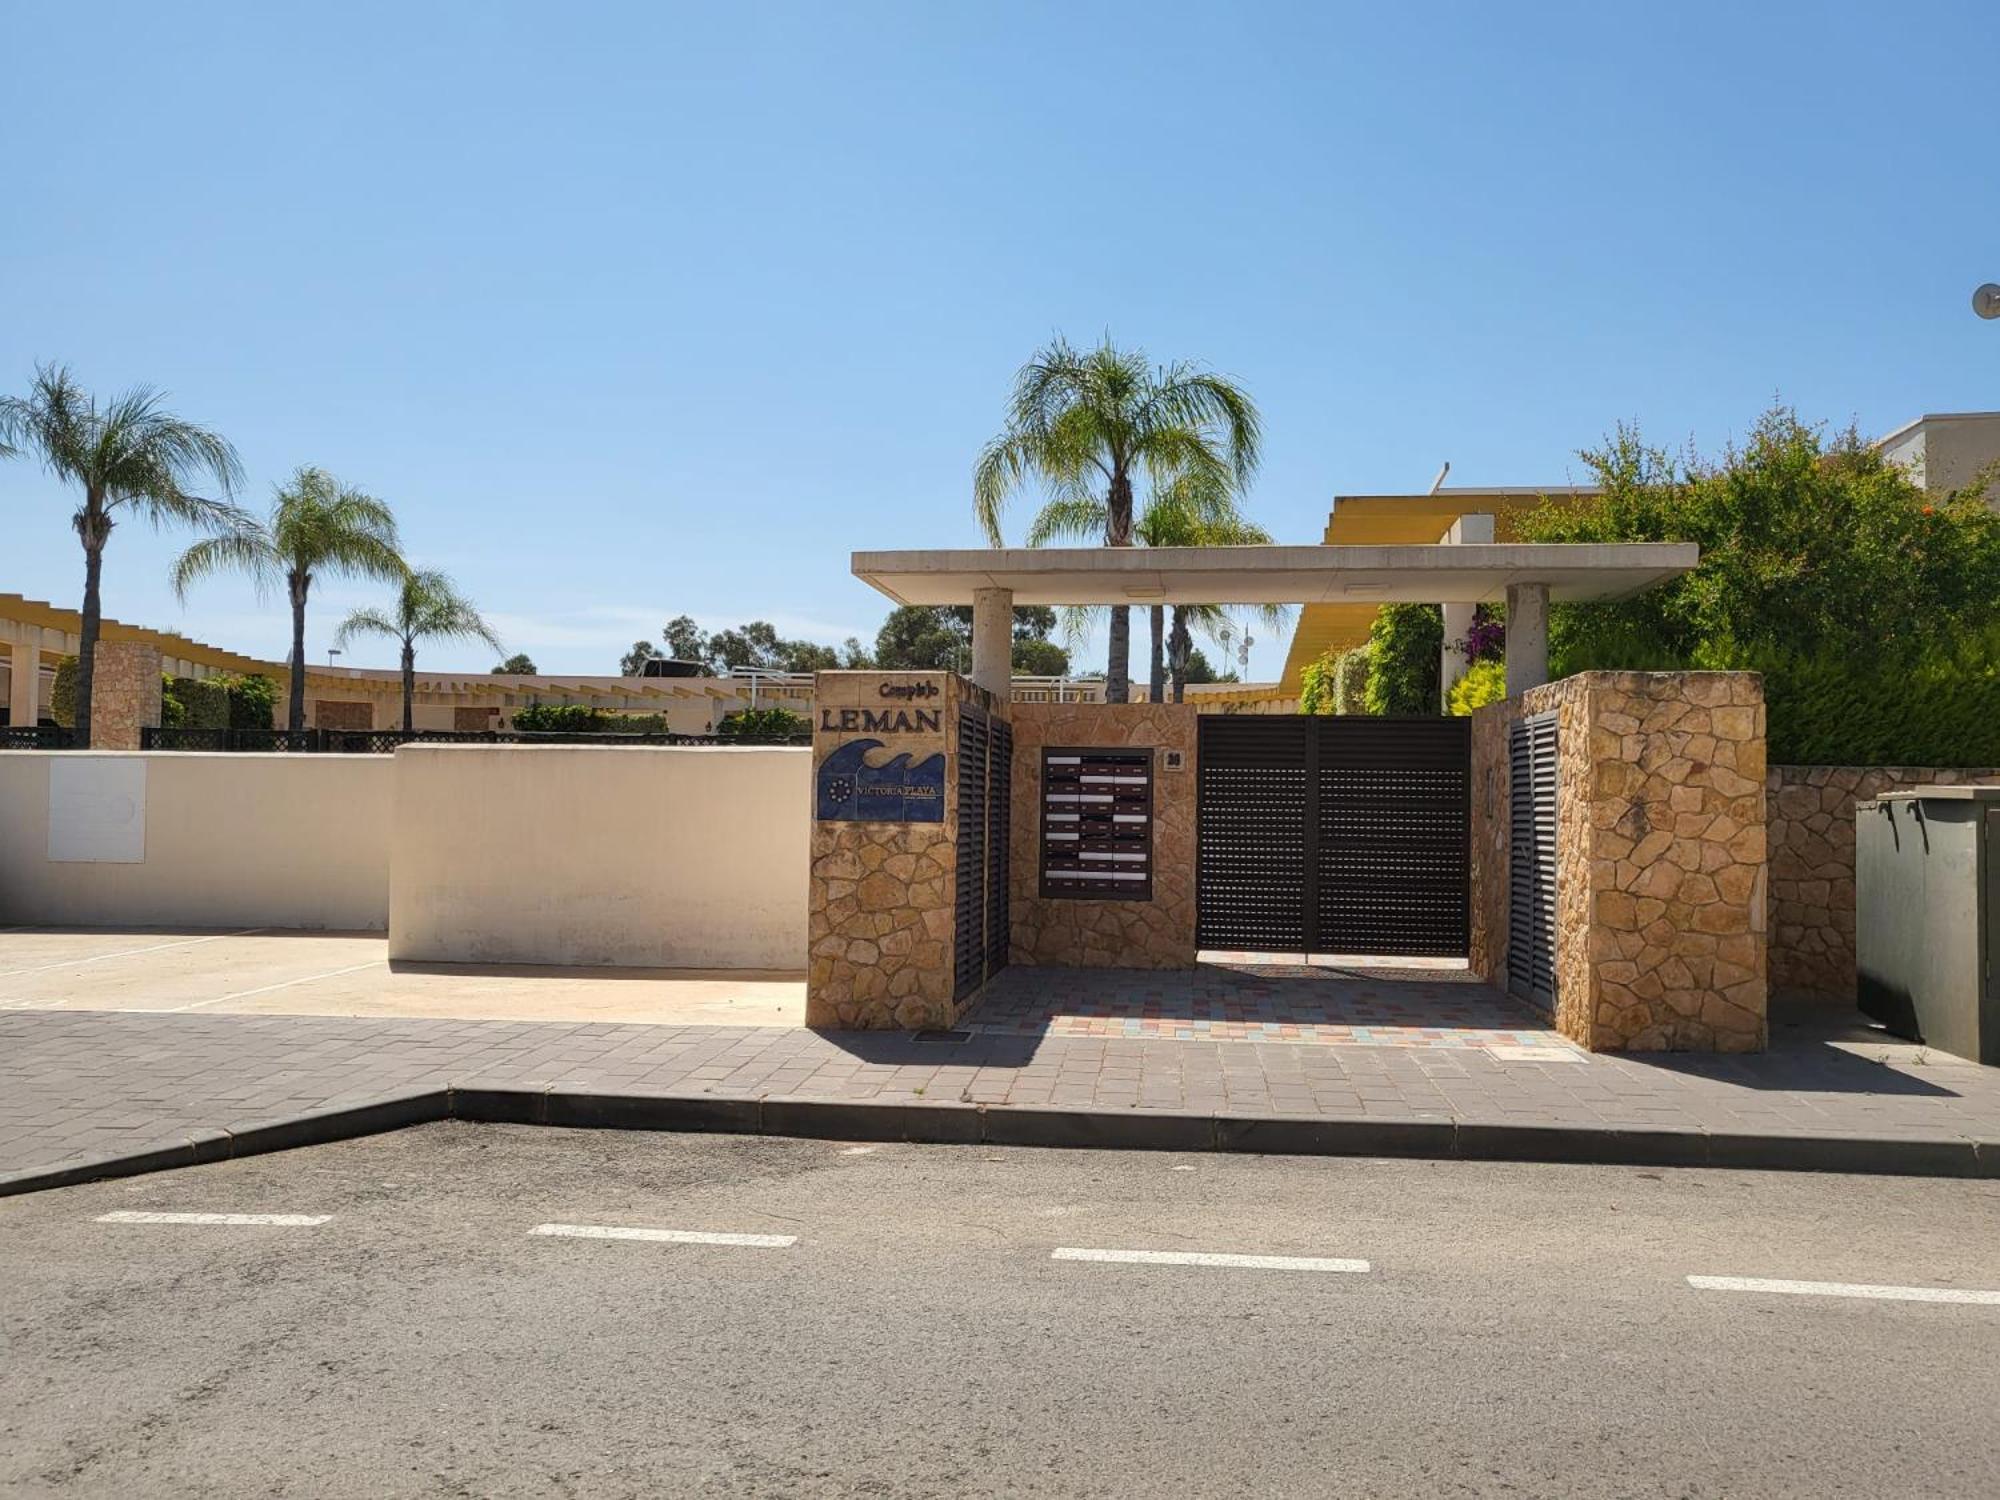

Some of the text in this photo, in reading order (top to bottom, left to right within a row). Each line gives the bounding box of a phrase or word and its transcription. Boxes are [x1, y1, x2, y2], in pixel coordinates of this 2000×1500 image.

[820, 709, 942, 732] LEMAN
[857, 785, 936, 796] VICTORIA PLAYA
